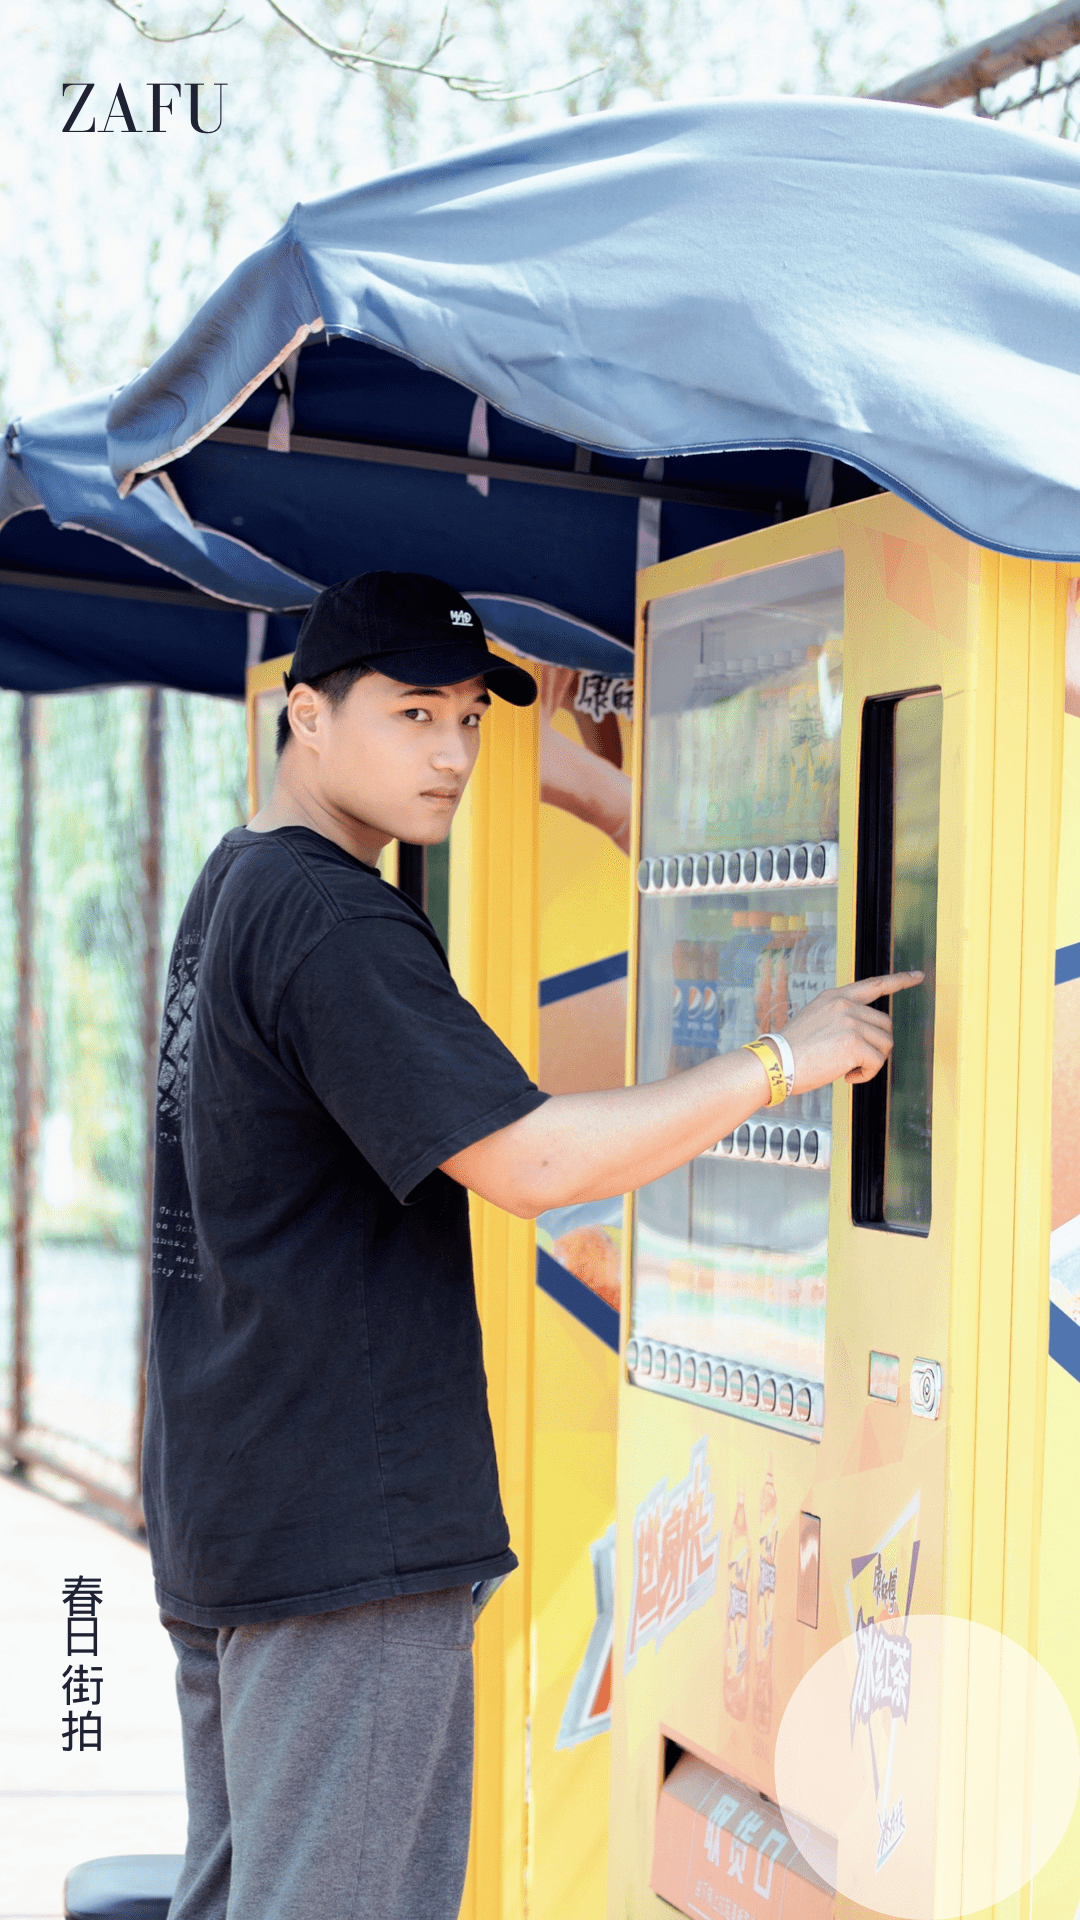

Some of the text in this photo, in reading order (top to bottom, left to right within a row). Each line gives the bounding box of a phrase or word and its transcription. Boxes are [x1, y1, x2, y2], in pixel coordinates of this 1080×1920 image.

[851, 1616, 911, 1724] 冰红茶
[703, 1793, 790, 1900] 取货口
